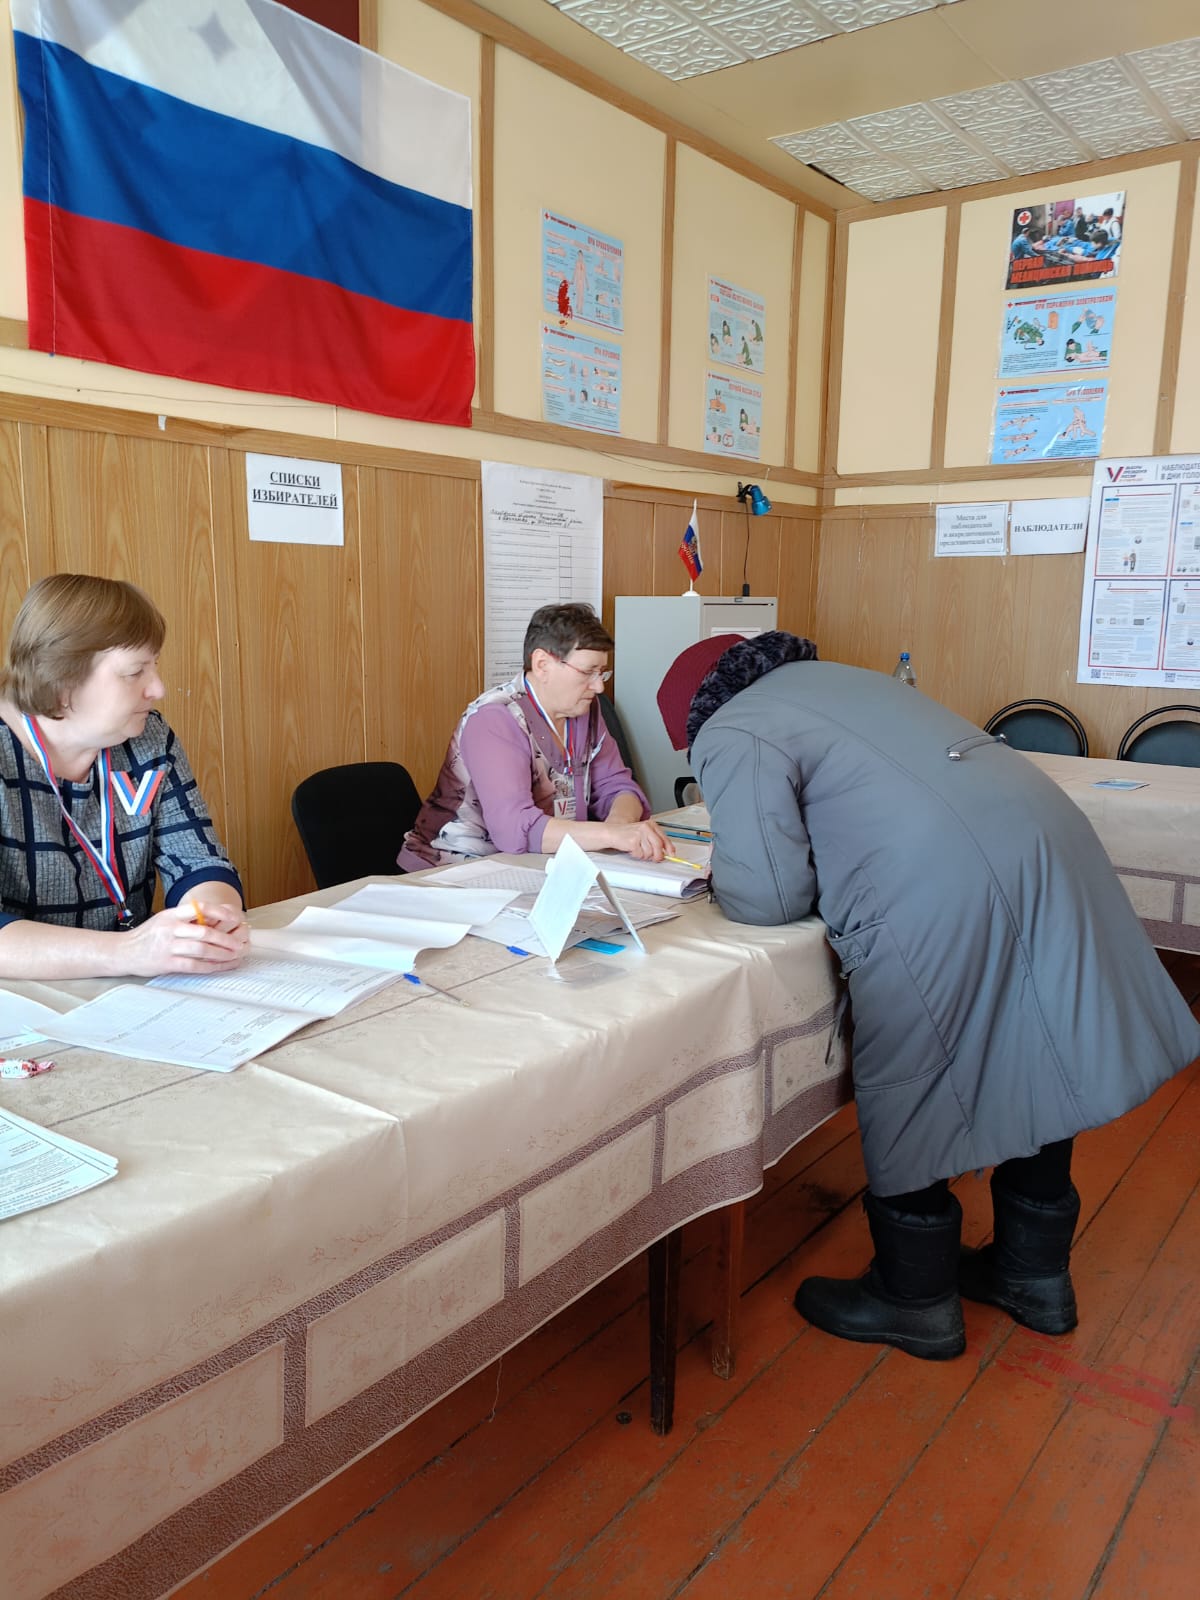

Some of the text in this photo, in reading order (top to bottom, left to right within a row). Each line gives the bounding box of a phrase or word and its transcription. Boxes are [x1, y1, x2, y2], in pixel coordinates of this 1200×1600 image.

[270, 471, 321, 488] СПИСКИ
[252, 488, 338, 508] ИЗБИРАТЕЛЕЙ
[1014, 521, 1084, 534] НАБЛЮДАТЕЛИ
